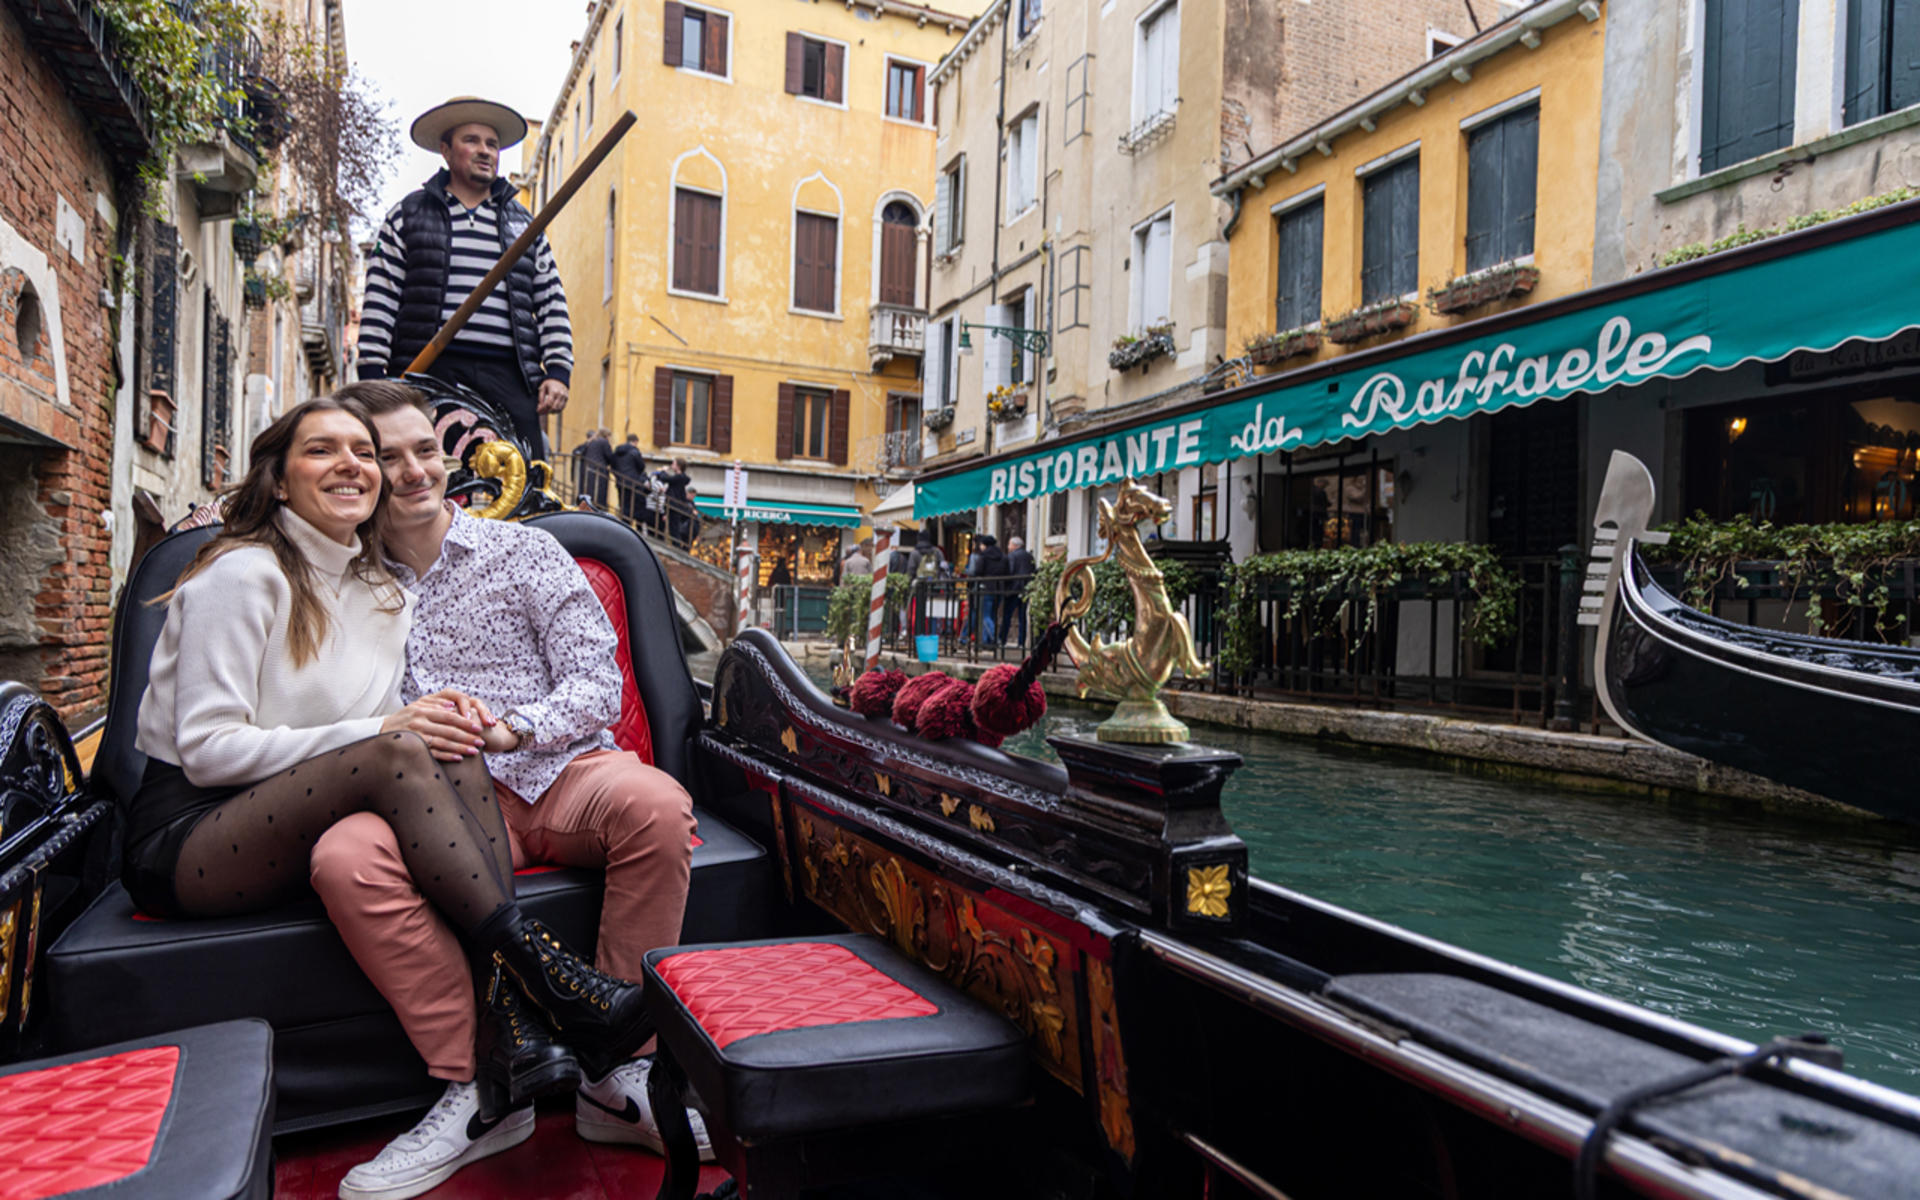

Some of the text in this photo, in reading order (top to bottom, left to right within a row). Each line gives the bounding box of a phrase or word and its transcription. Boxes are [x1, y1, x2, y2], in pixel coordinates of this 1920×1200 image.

[989, 316, 1711, 502] RISTORANTE da Raffaele
